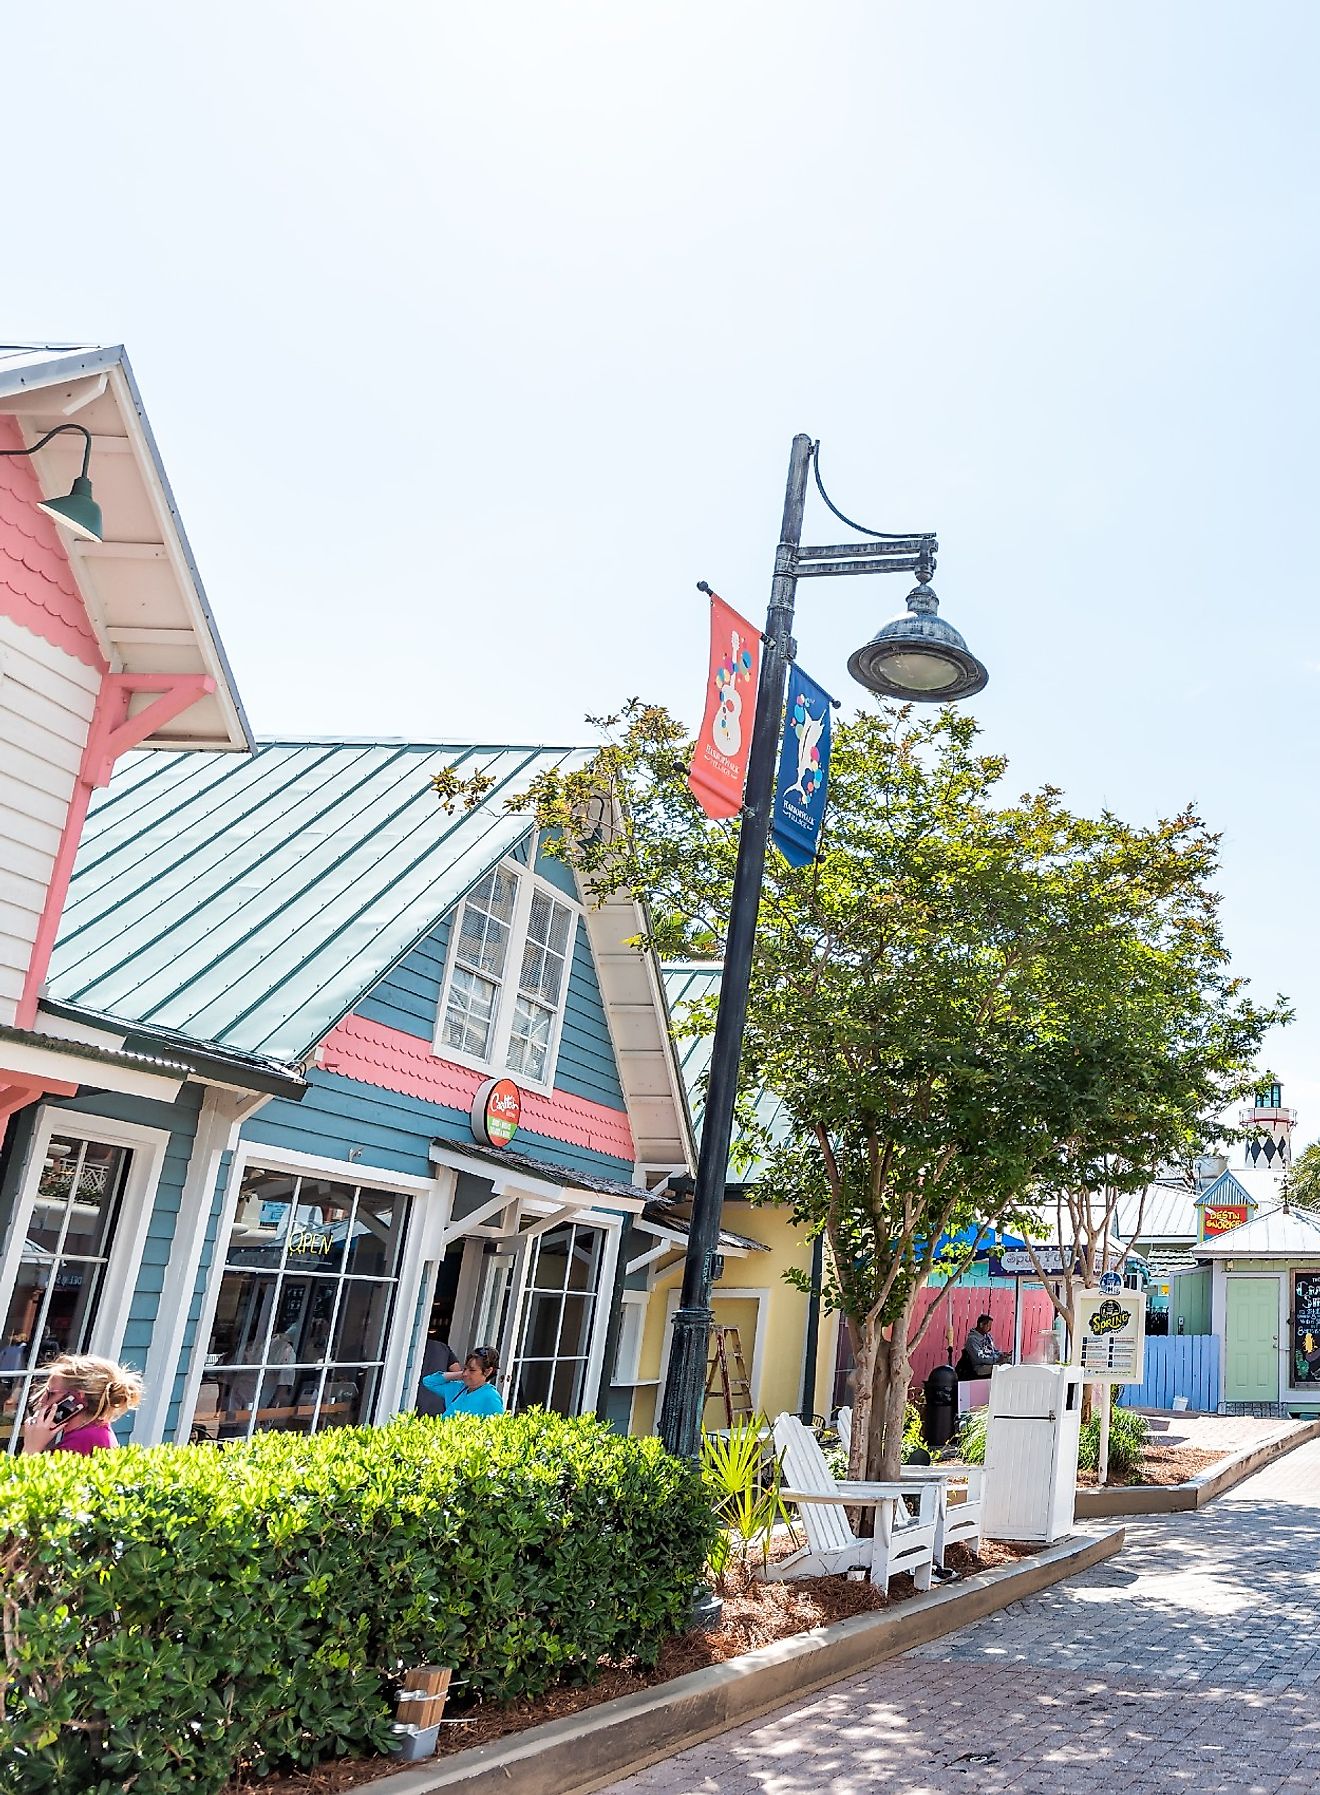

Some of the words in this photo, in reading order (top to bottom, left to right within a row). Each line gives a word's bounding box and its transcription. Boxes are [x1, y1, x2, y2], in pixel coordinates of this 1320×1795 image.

[1210, 1210, 1240, 1220] DESTIN
[288, 1231, 334, 1257] OPEN
[1092, 1311, 1130, 1334] SPRING
